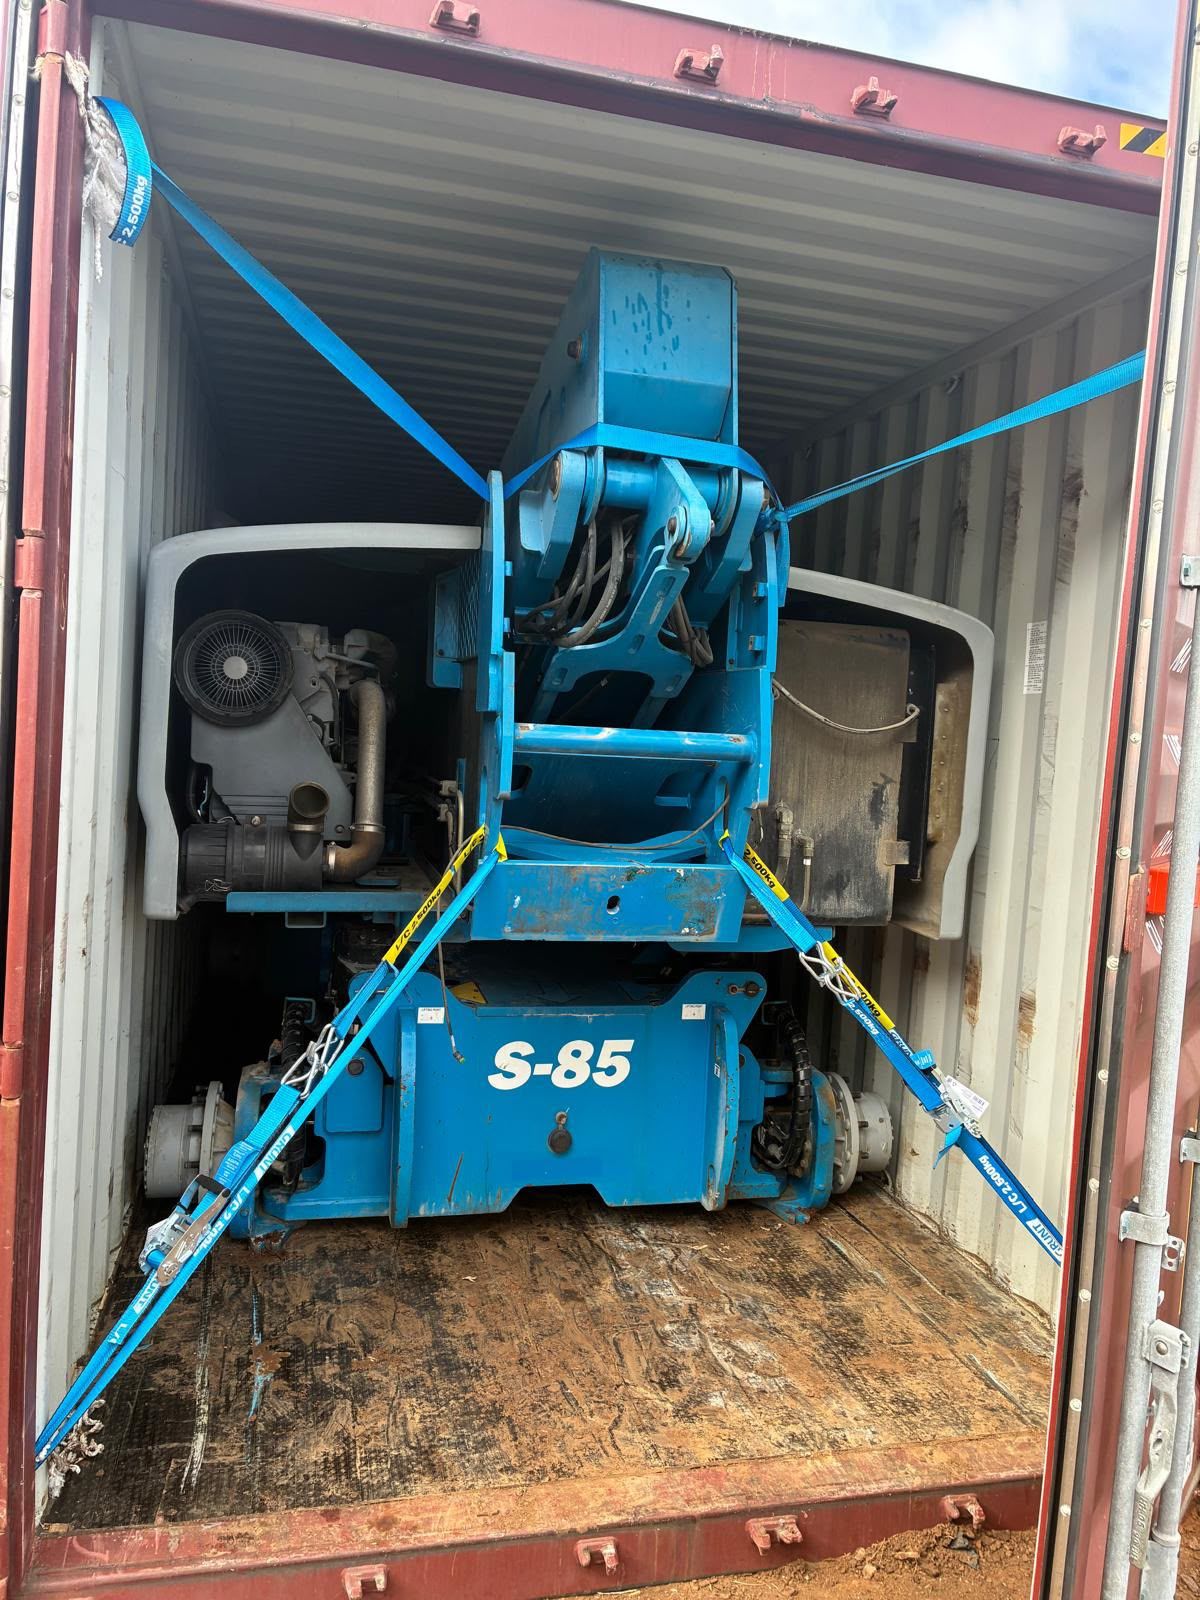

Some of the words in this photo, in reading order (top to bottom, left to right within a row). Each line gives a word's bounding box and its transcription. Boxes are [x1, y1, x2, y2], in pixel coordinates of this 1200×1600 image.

[122, 175, 148, 238] 2,500kg
[395, 928, 412, 951] L/C
[488, 1040, 635, 1091] S-85
[978, 1155, 1014, 1195] 2,500kg
[230, 1186, 251, 1212] L/C
[1008, 1192, 1028, 1214] L/C
[138, 1278, 160, 1307] UNT
